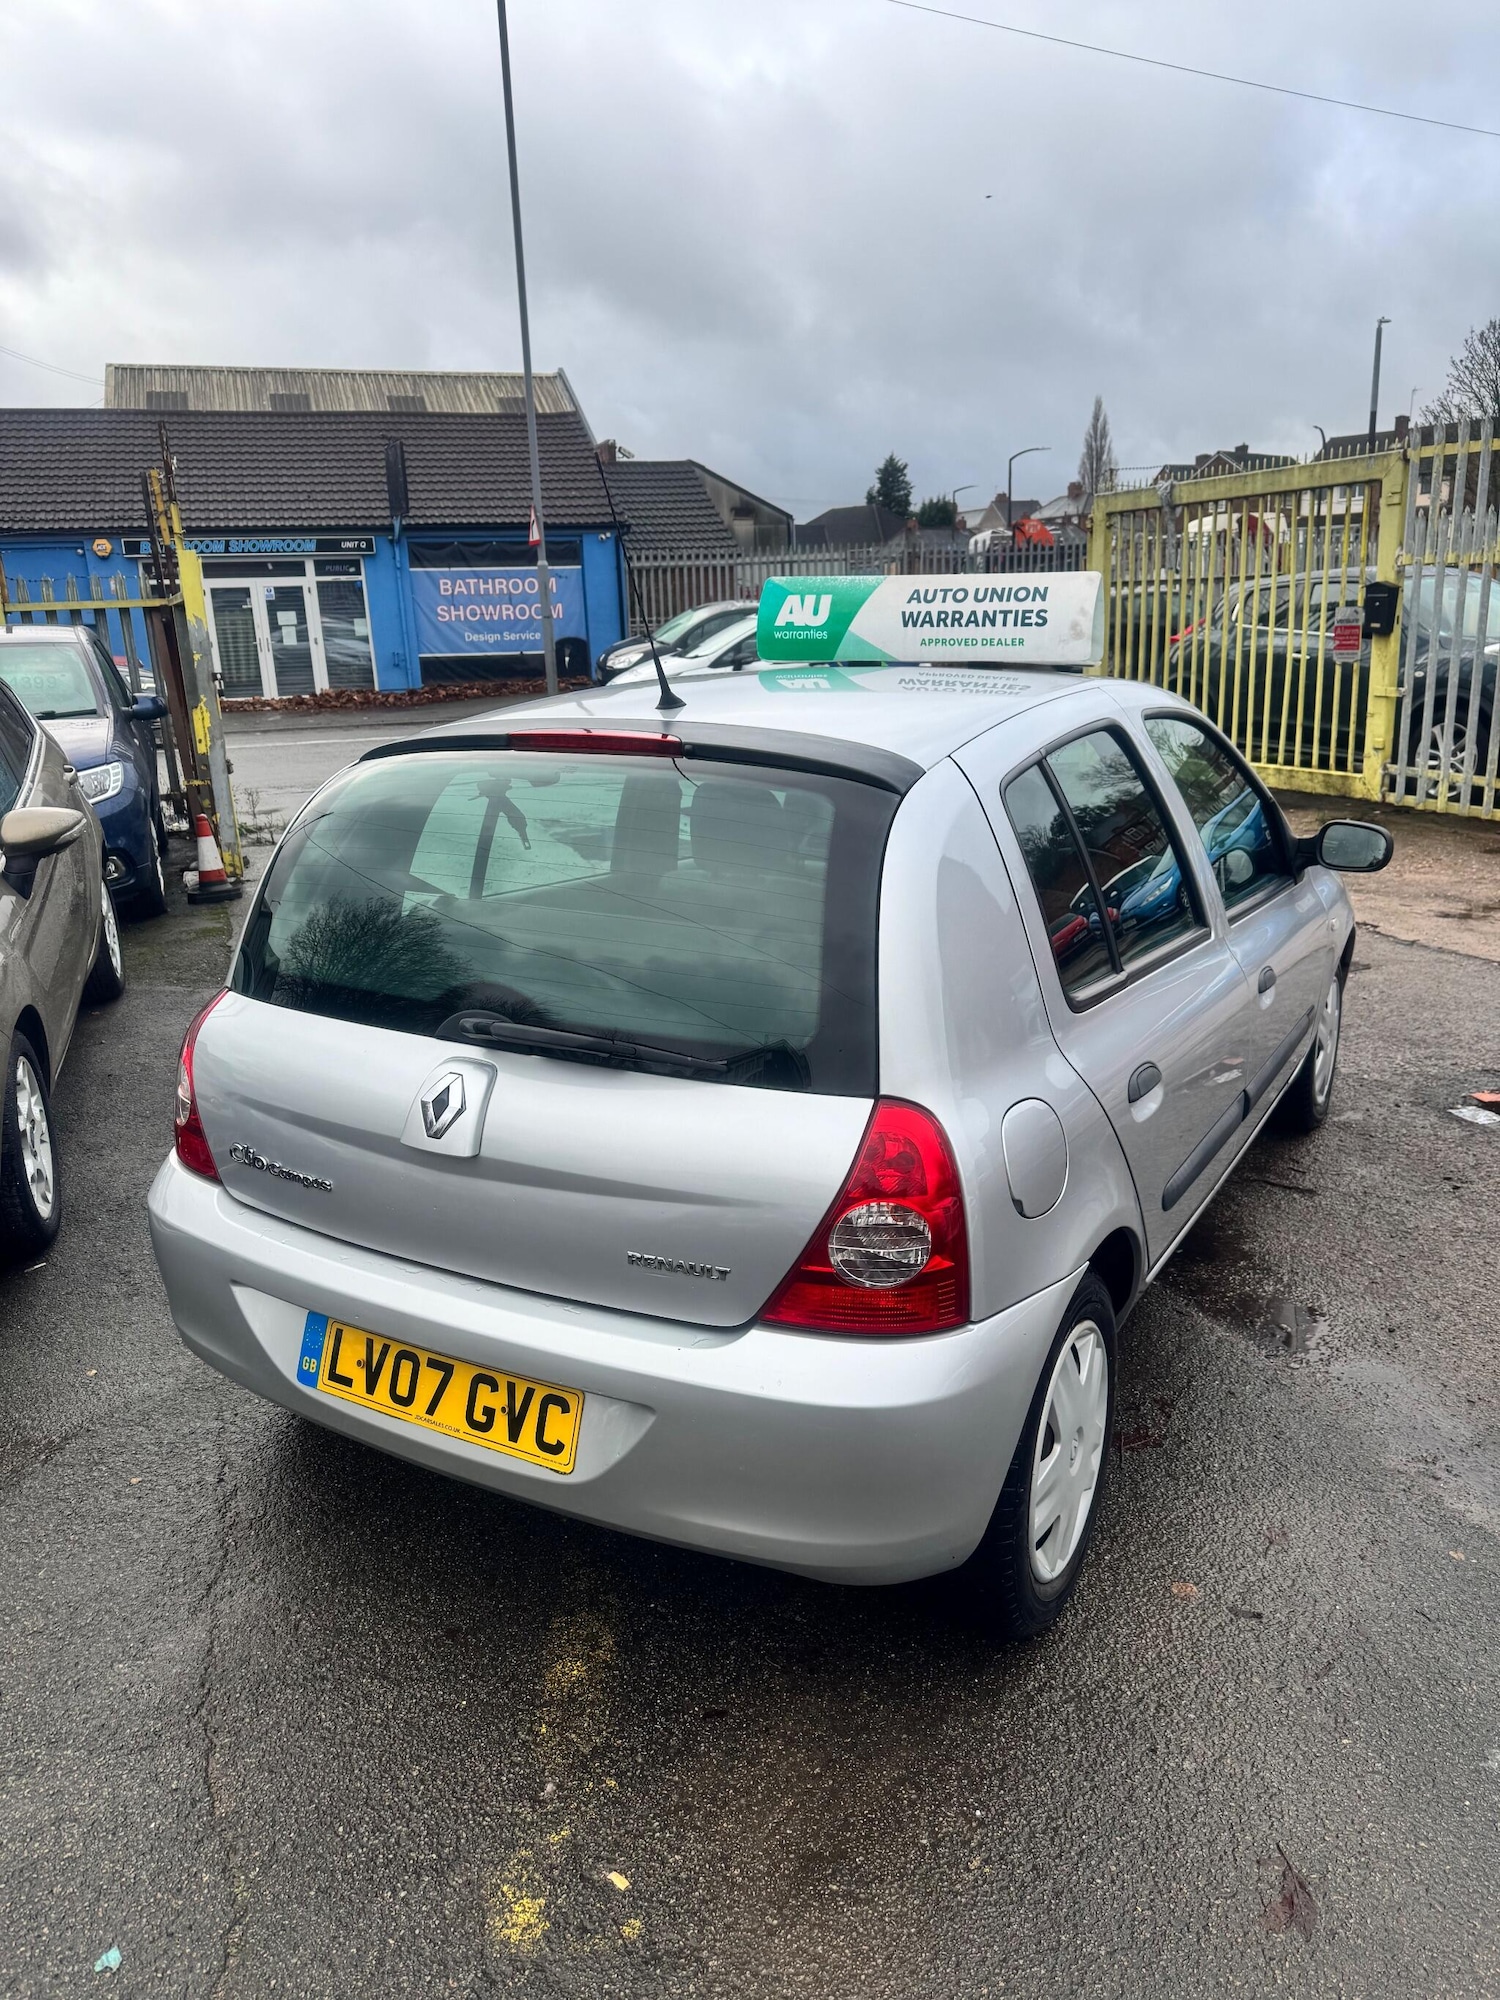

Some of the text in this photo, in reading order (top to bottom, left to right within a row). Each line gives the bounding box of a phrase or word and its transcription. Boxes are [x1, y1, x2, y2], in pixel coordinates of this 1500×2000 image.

[229, 540, 316, 552] SHOWROOM
[341, 541, 367, 549] UNIT Q
[907, 586, 1048, 604] AUTO UNION
[437, 603, 563, 621] SHOWROOM
[774, 594, 832, 627] AU
[901, 609, 1048, 628] WARRANTIES
[465, 630, 541, 643] Design Service
[774, 629, 828, 640] warranties
[920, 637, 1025, 647] APPROVED DEALER
[230, 1142, 269, 1171] Clio
[627, 1250, 732, 1282] RENAULT
[302, 1355, 318, 1374] GB
[327, 1327, 571, 1456] LV07 GVC
